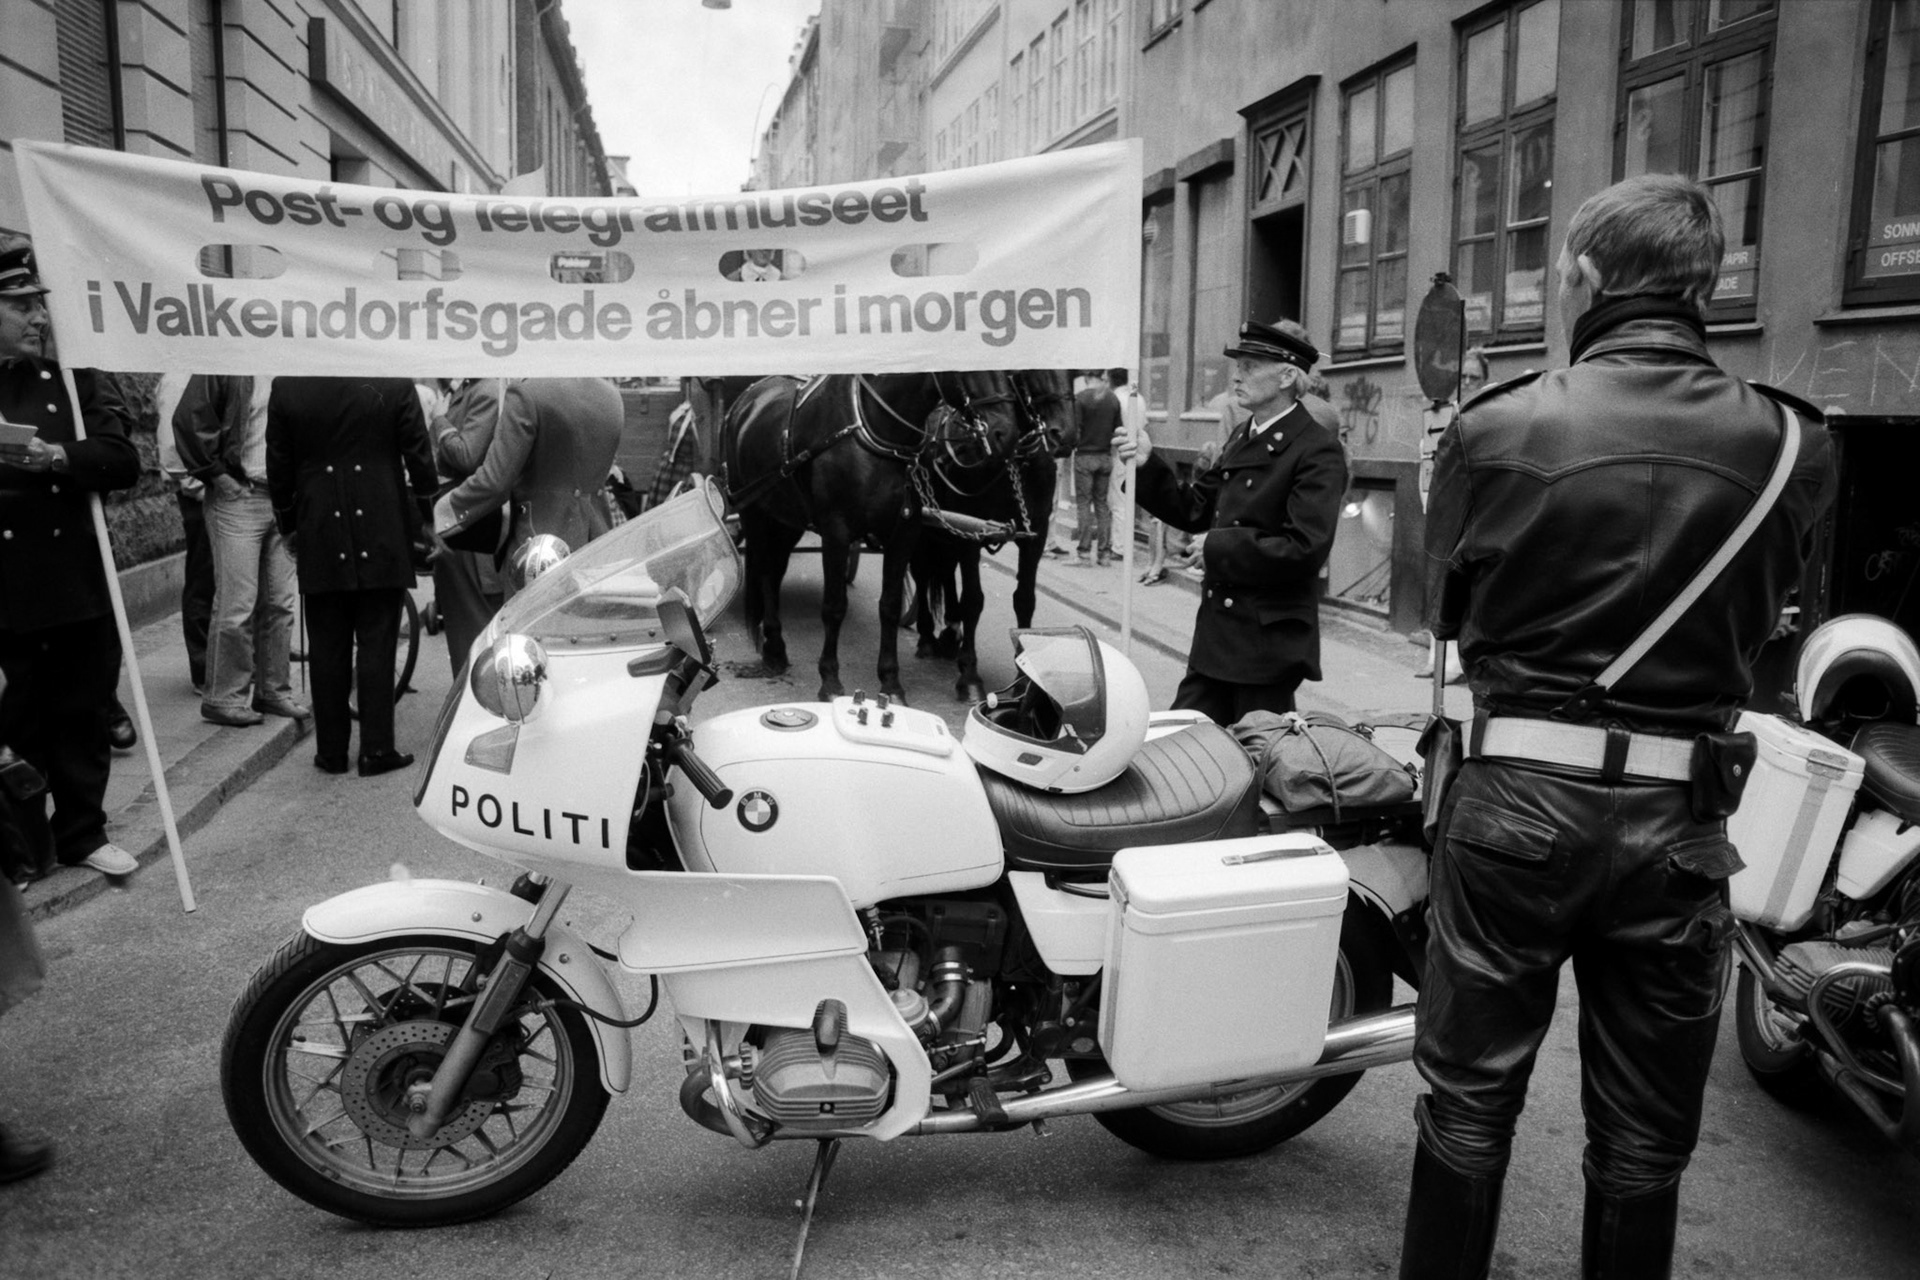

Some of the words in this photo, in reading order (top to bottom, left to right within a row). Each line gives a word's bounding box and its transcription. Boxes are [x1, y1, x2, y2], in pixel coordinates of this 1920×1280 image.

[201, 173, 363, 228] Post-
[373, 195, 457, 247] og
[475, 177, 929, 248] Telegrafmuseet
[87, 280, 105, 334] i
[113, 281, 632, 358] Valkendorfsgade
[645, 288, 822, 341] åbner
[834, 284, 848, 335] i
[858, 287, 1092, 347] morgen
[451, 784, 610, 849] POLITI
[740, 791, 776, 807] BMW
